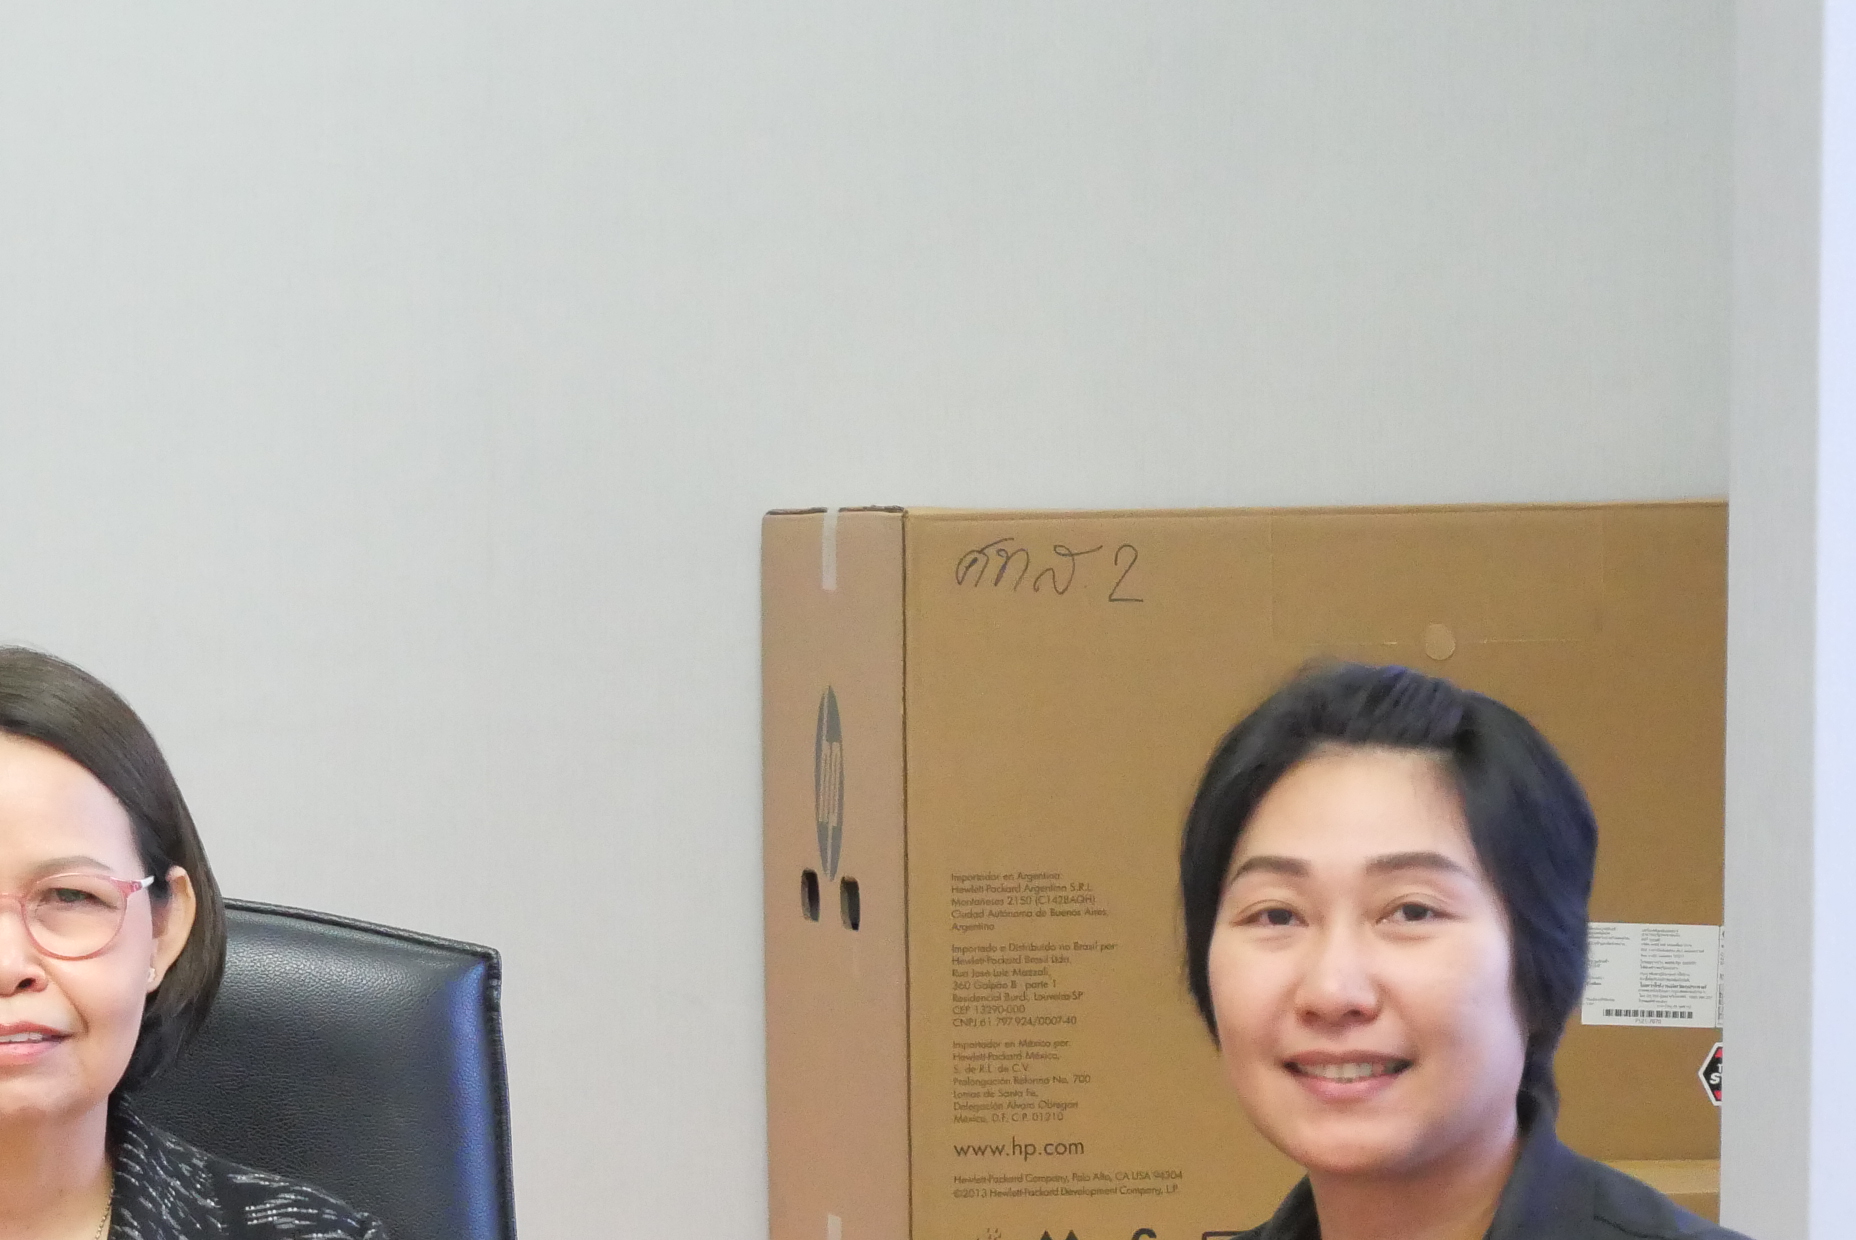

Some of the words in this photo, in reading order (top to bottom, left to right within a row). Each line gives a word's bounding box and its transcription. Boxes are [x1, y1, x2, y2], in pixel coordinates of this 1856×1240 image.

[1108, 544, 1144, 602] 2
[951, 871, 1001, 883] Importador
[1024, 883, 1067, 894] Argentina
[1007, 896, 1032, 906] 2150
[951, 909, 984, 919] Ciudad
[1036, 909, 1047, 918] de
[1050, 908, 1081, 917] Buenos
[951, 922, 995, 933] Argentina
[951, 943, 998, 955] Importado
[1074, 941, 1097, 951] Brasil
[1024, 955, 1048, 964] Brasil
[951, 968, 968, 978] Rua
[952, 981, 970, 991] 360
[1025, 980, 1048, 991] parte
[951, 993, 1001, 1003] Residencial
[952, 1005, 971, 1015] CEP
[952, 1040, 1001, 1051] Importador
[965, 1064, 976, 1073] de
[998, 1064, 1009, 1073] de
[1073, 1074, 1091, 1084] 700
[953, 1090, 981, 1099] Lomas
[984, 1090, 995, 1098] de
[998, 1090, 1023, 1098] Santa
[1032, 1112, 1064, 1121] 01210
[954, 1136, 1084, 1162] www.hp.com
[1072, 1172, 1091, 1182] Palo
[1115, 1172, 1130, 1181] CA
[1132, 1171, 1151, 1180] USA
[1060, 1185, 1118, 1197] Development
